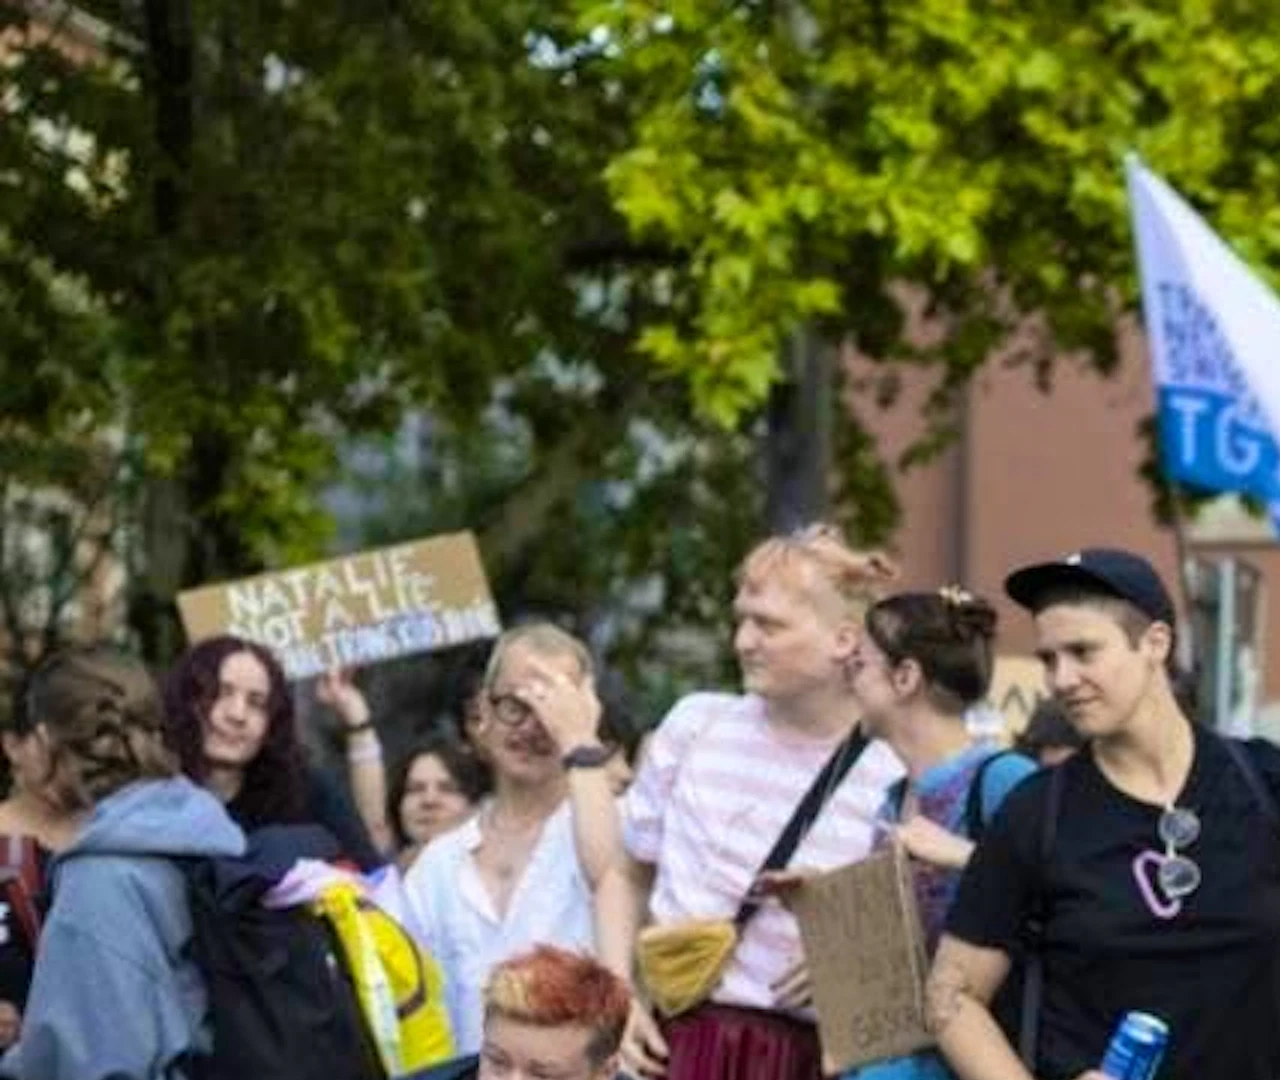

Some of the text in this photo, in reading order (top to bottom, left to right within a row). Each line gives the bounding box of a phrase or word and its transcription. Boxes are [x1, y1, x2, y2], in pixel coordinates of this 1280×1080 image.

[226, 548, 417, 616] NATALIE
[323, 600, 356, 629] A
[368, 575, 437, 616] LIE
